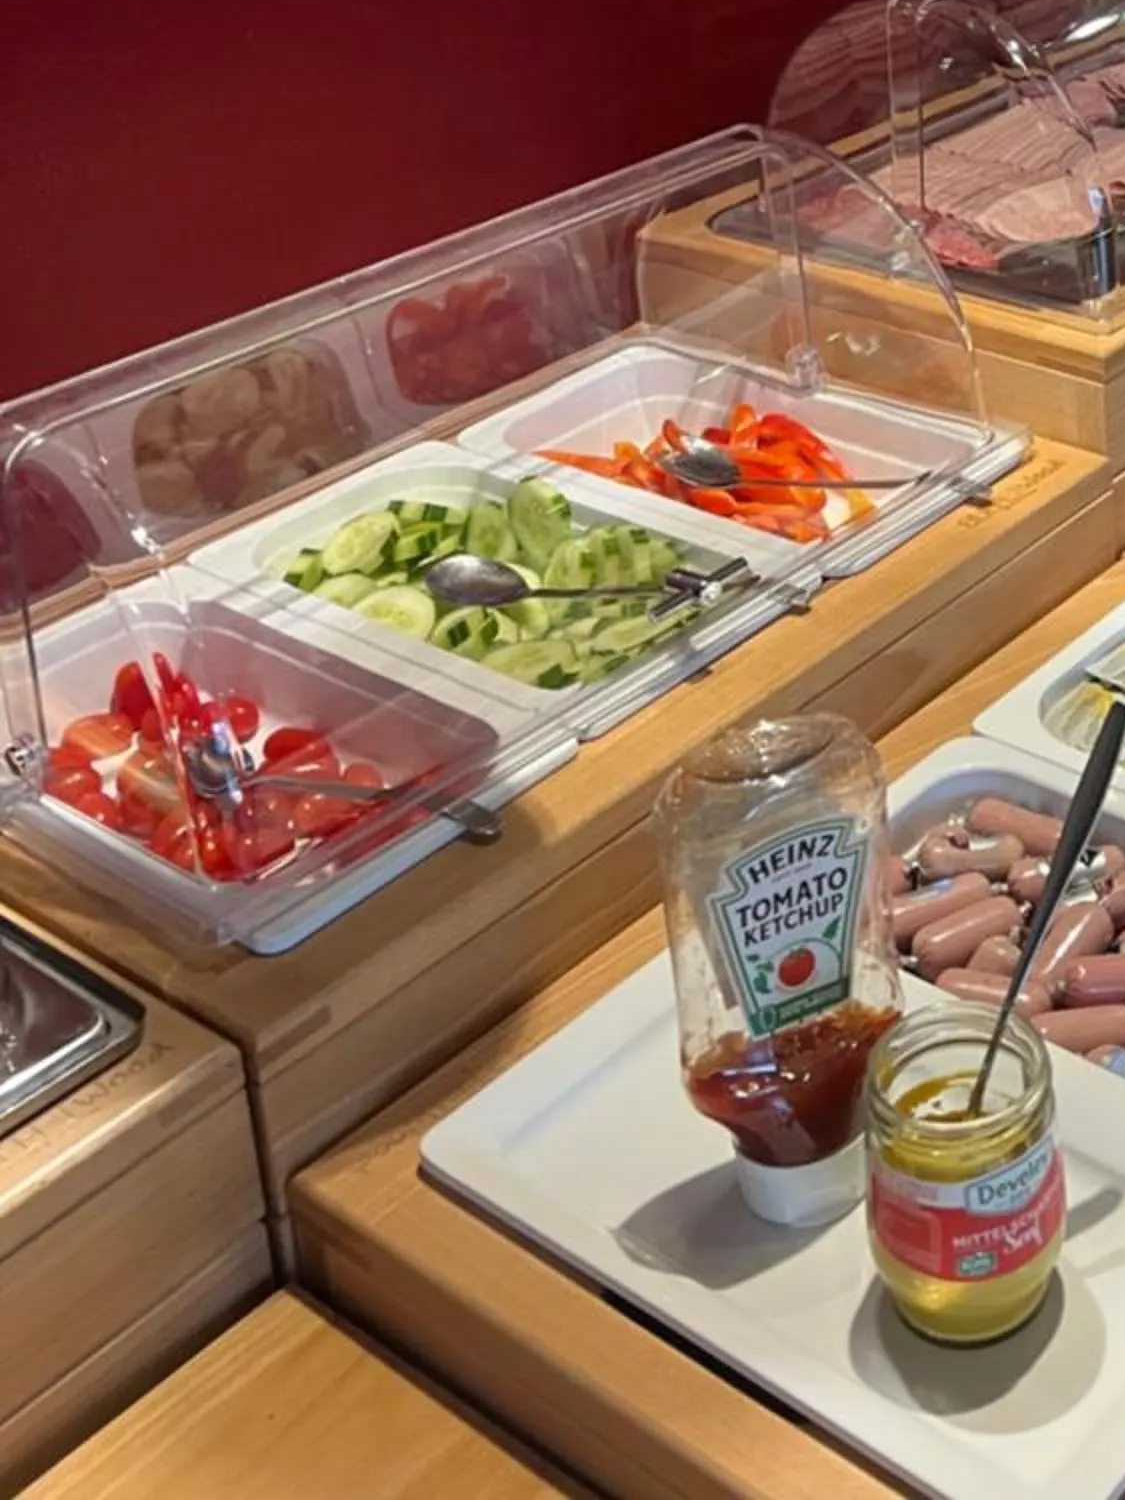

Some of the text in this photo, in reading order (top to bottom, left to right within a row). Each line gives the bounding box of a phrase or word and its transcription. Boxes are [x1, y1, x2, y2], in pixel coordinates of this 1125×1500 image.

[748, 833, 835, 885] HEINZ
[736, 866, 848, 929] TOMATO
[743, 892, 844, 948] KETCHUP
